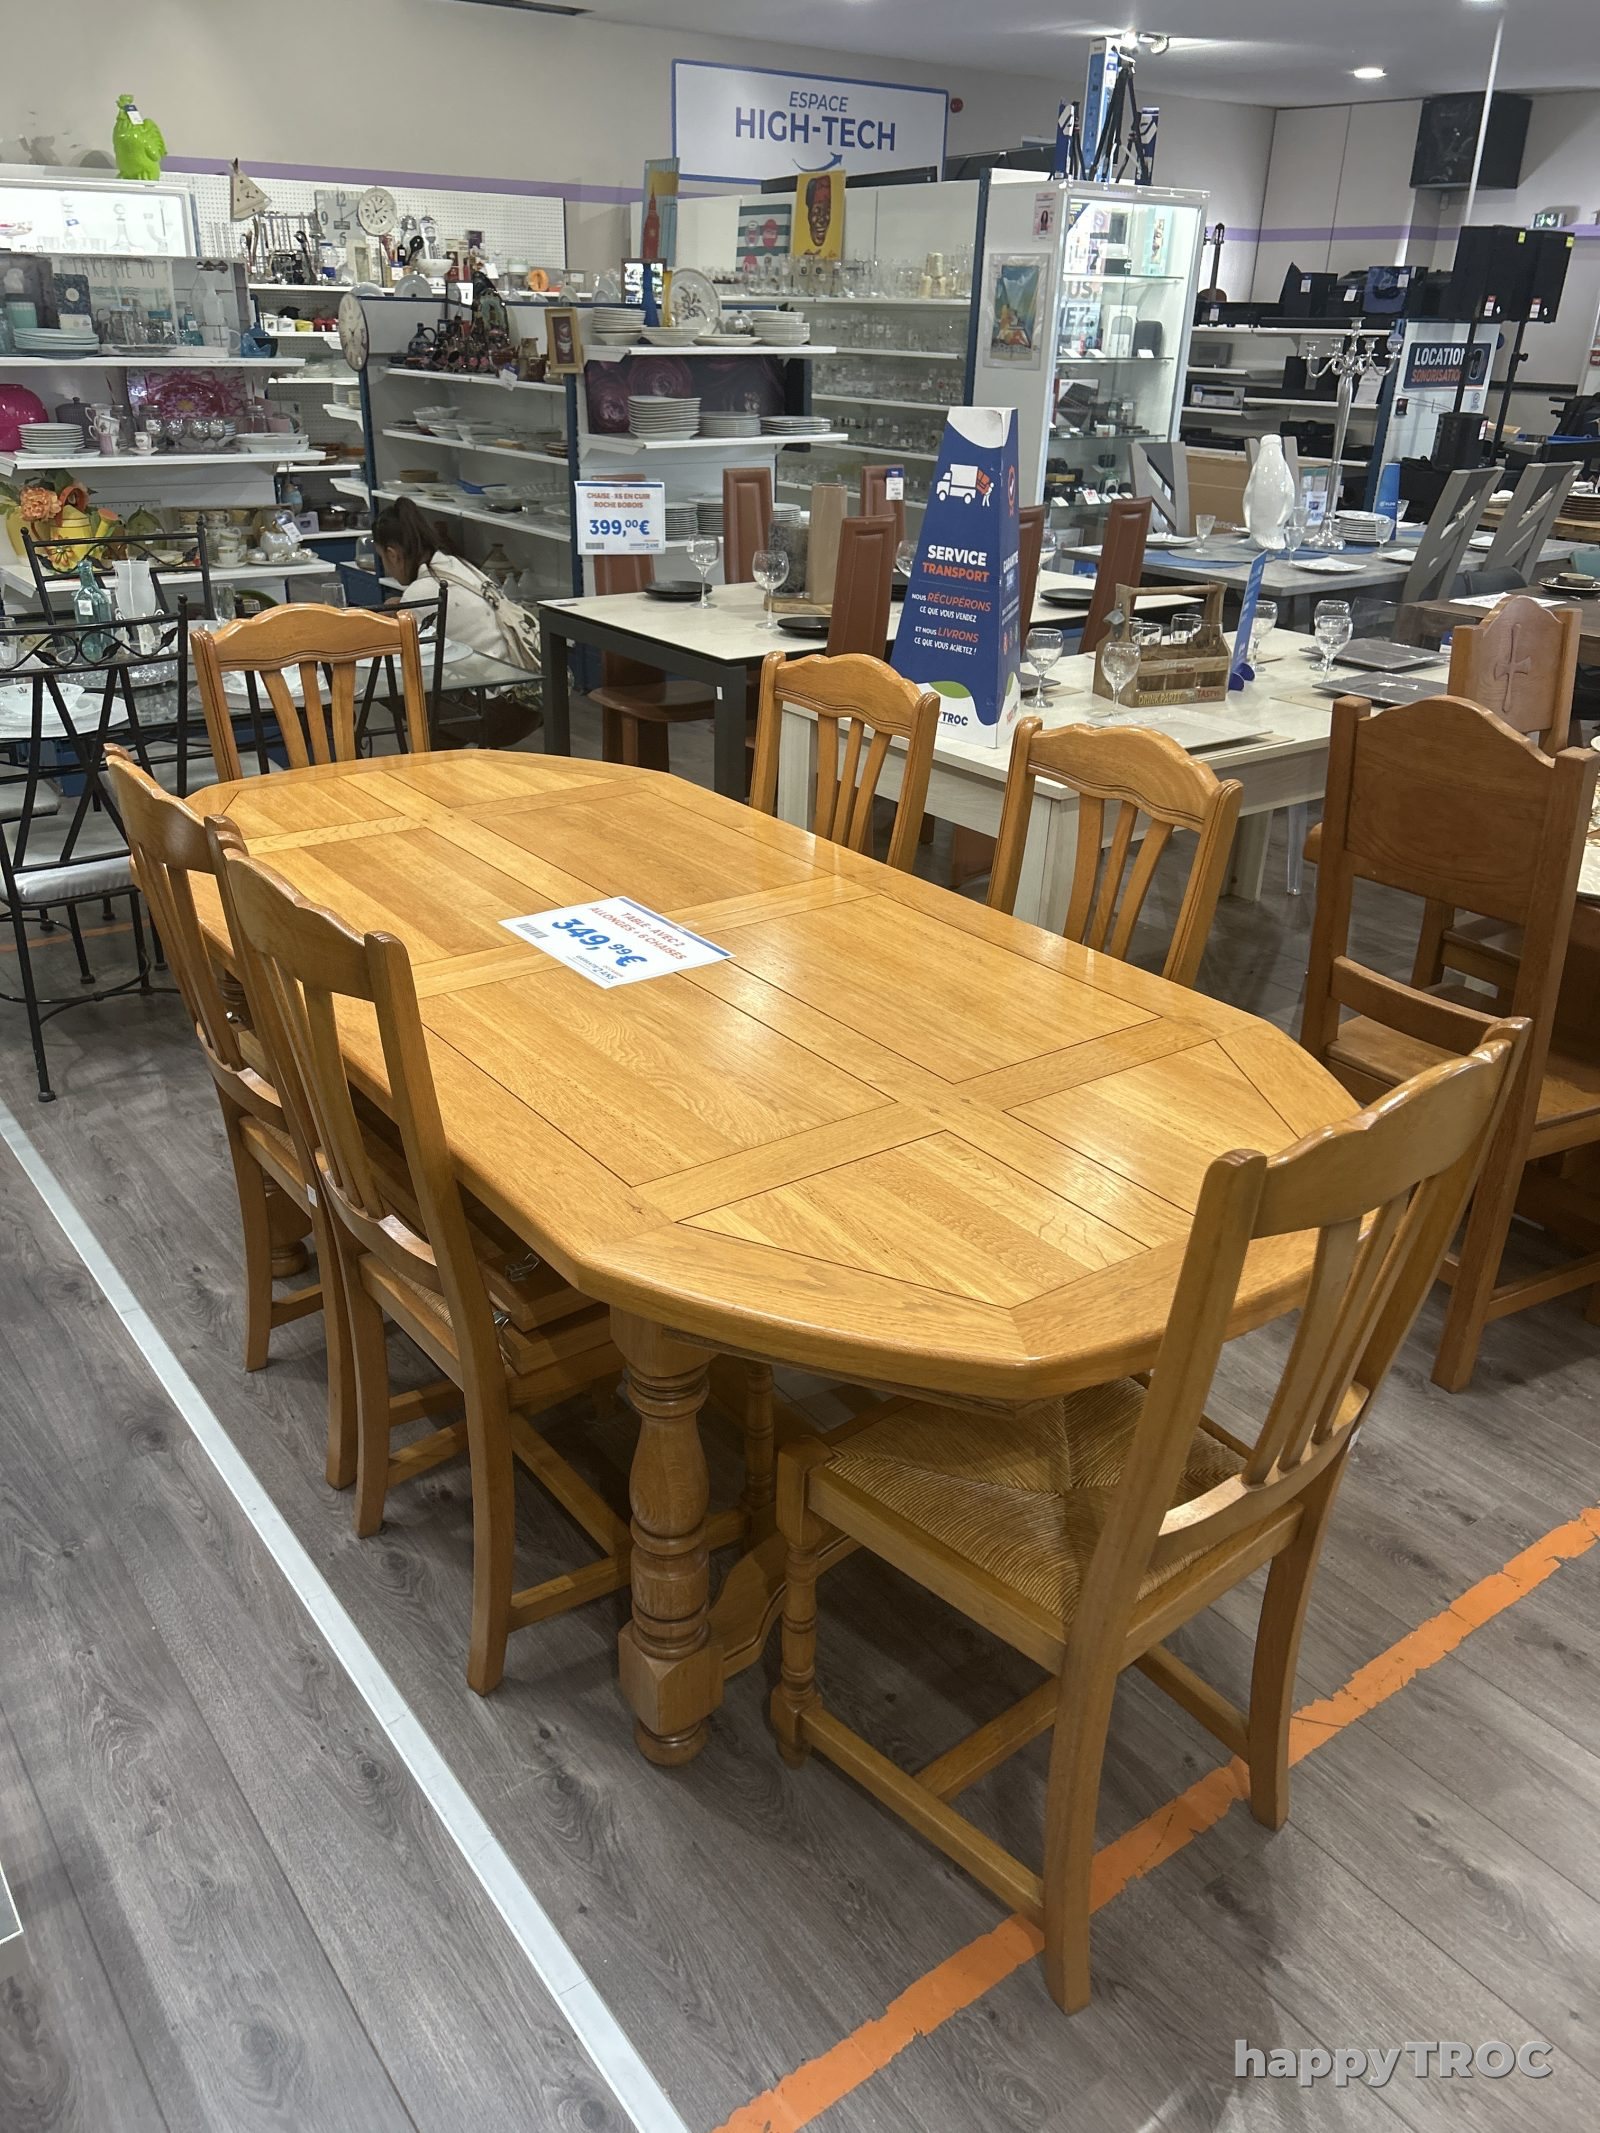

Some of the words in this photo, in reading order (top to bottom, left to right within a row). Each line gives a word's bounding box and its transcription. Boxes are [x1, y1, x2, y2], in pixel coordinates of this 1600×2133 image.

[789, 91, 848, 112] ESPACE
[736, 107, 896, 151] HIGH-TECH
[321, 211, 329, 226] 9
[1411, 369, 1462, 383] SONORISATIO
[927, 544, 988, 567] SERVICE
[922, 562, 990, 583] TRANSPORT
[911, 593, 927, 601] NOUS
[927, 592, 992, 612] RÉCUPÉRONS
[919, 605, 927, 613] CE
[927, 607, 939, 617] QUE
[940, 609, 955, 619] VOUS
[955, 612, 977, 623] VENDEZ
[922, 627, 937, 636] NOUS
[937, 627, 980, 643] LIVRONS
[914, 637, 921, 645] CE
[921, 638, 933, 647] QUE
[934, 640, 949, 650] VOUS
[949, 643, 973, 656] ACHETEZ
[940, 711, 969, 726] TROC
[589, 907, 635, 932] ALLONGES
[644, 937, 688, 960] CHAISES
[621, 912, 649, 929] TABLE
[651, 928, 680, 944] AVEC
